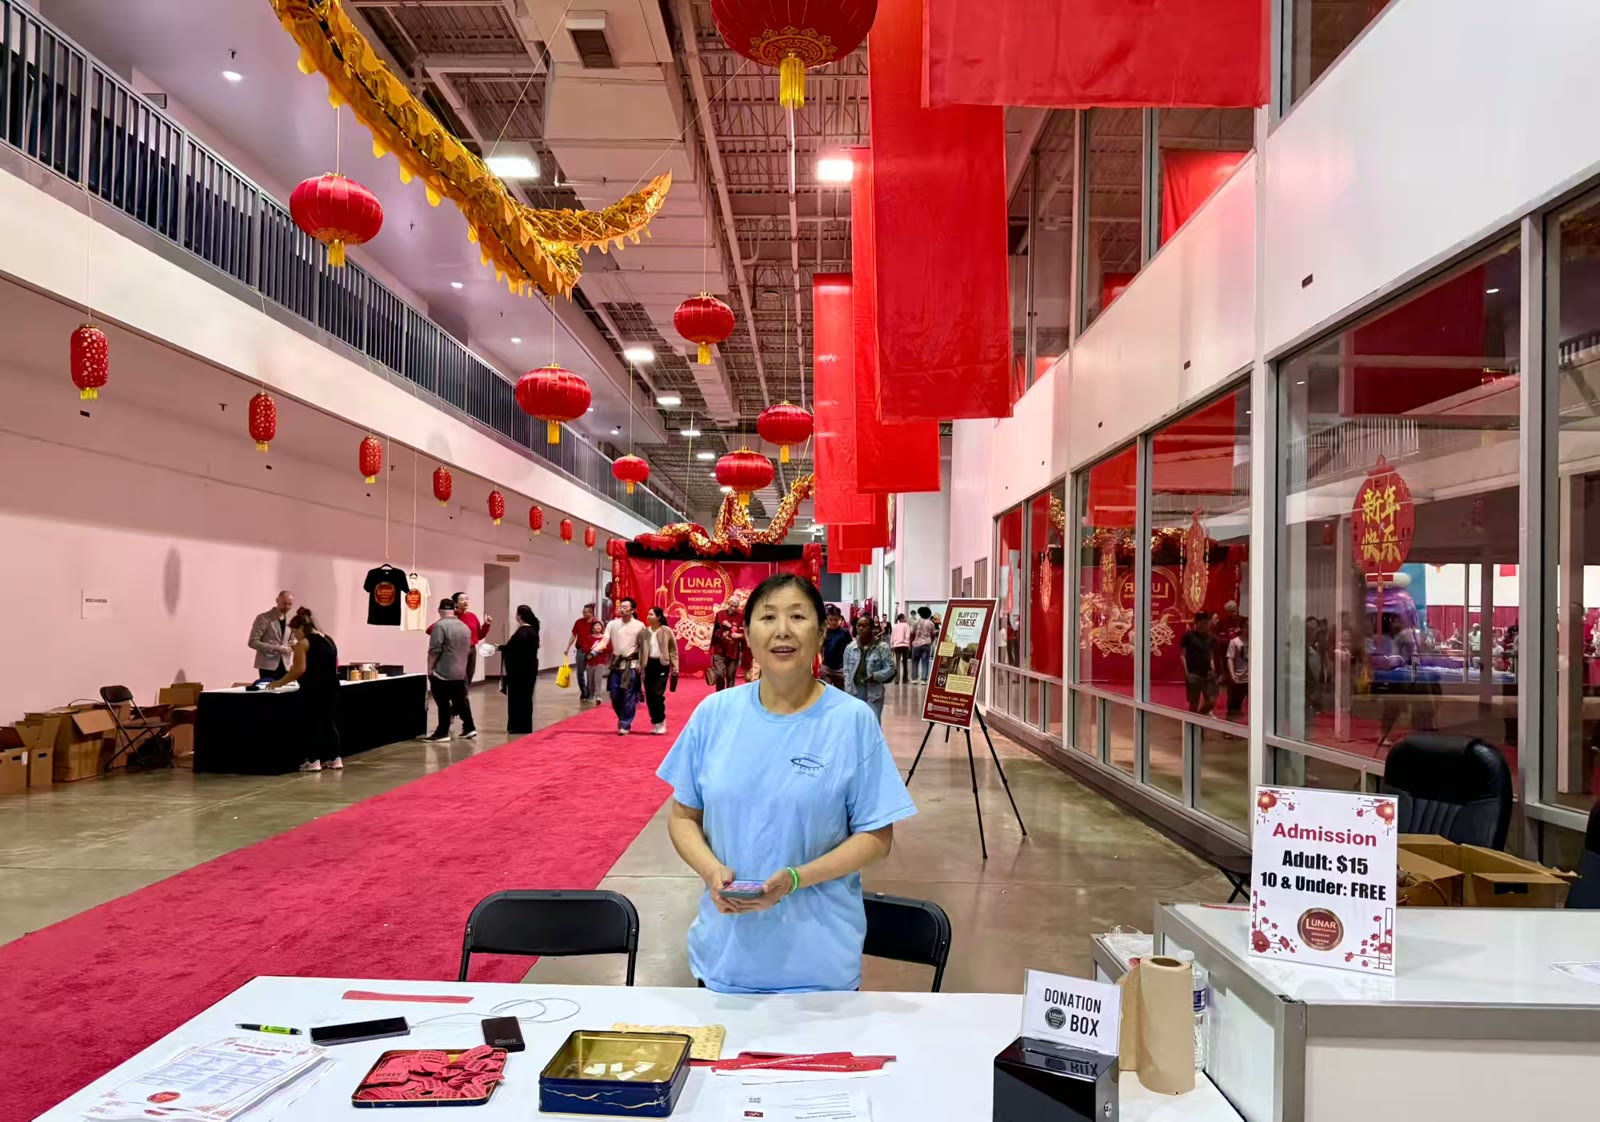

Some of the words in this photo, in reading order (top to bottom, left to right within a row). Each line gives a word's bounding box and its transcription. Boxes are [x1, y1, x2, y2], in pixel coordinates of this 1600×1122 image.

[679, 577, 722, 594] LUNAR
[955, 618, 977, 627] CHINESE
[1272, 822, 1377, 847] Admission
[1282, 850, 1333, 871] Adult:
[1336, 854, 1369, 875] $15
[1260, 871, 1278, 888] 10
[1281, 876, 1292, 890] &
[1295, 875, 1348, 897] Under:
[1350, 882, 1387, 901] FREE
[1305, 918, 1337, 930] LUNAR
[1044, 988, 1102, 1014] DONATION
[1070, 1014, 1100, 1037] BOX
